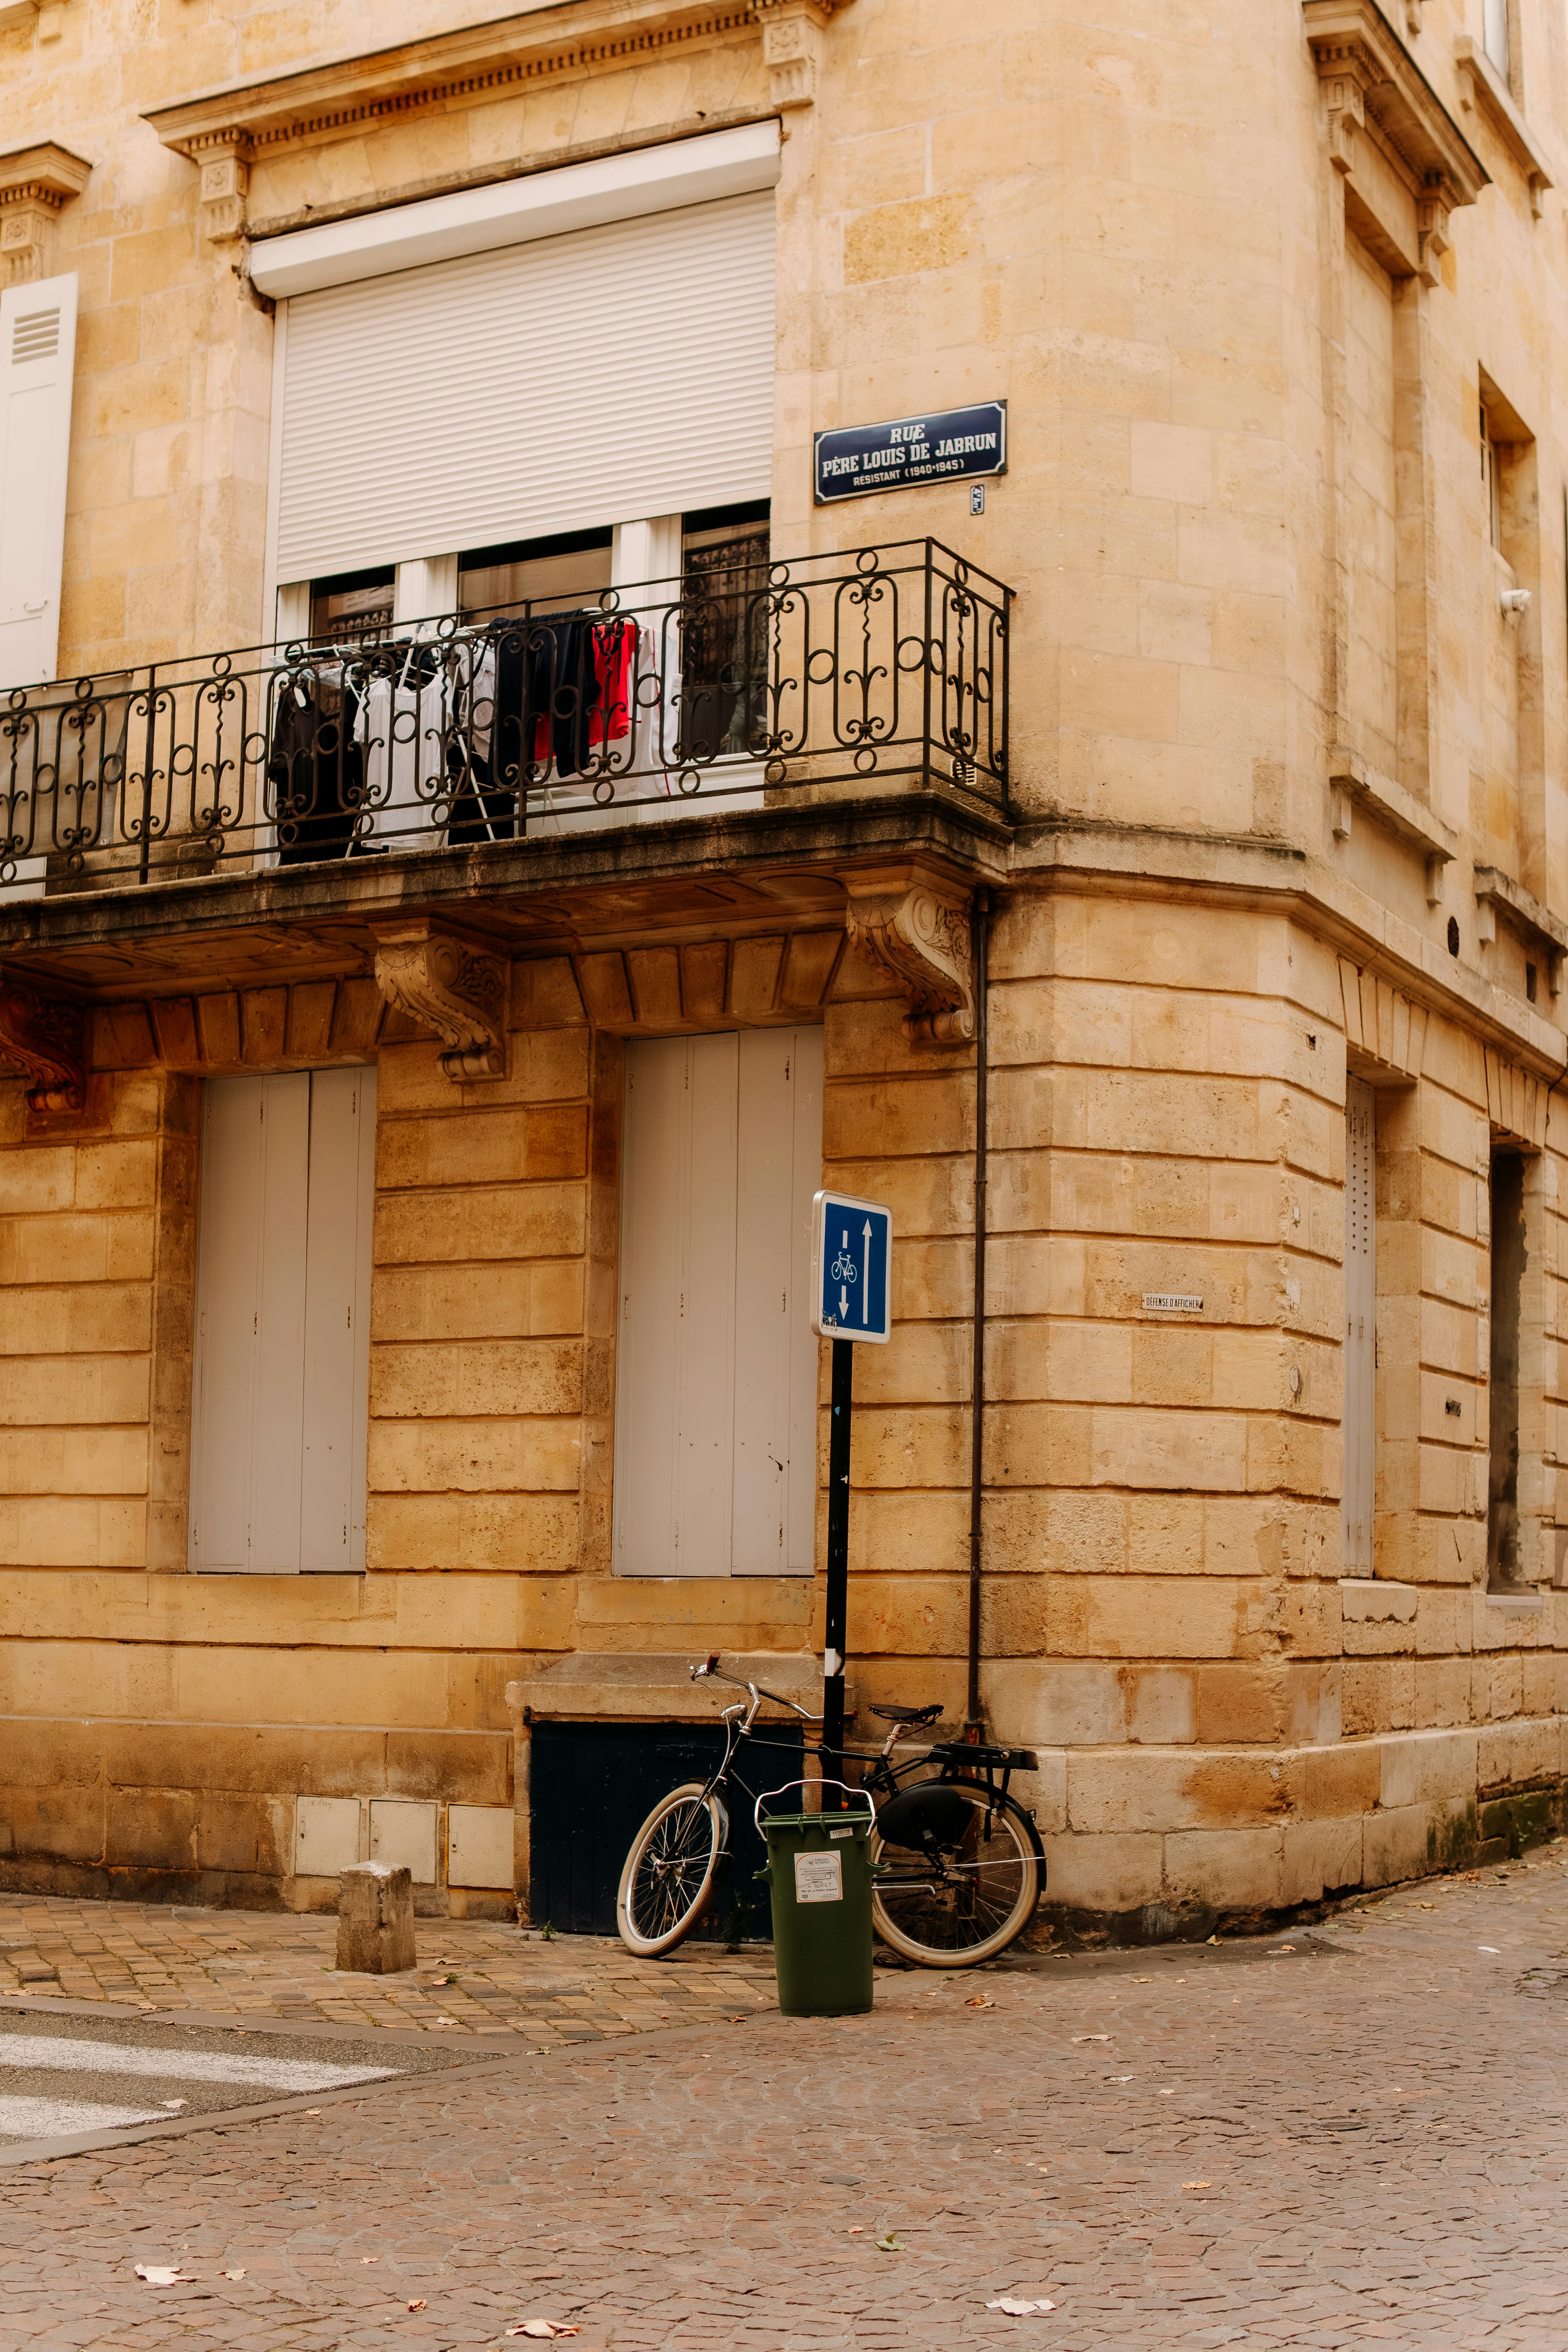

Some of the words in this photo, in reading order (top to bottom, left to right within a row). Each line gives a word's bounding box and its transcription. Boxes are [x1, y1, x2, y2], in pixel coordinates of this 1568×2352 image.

[889, 424, 926, 444] RUE
[822, 456, 859, 477] PÈRE
[863, 446, 906, 470] LOUIS
[910, 443, 930, 461] DE
[935, 432, 996, 457] JABRUN
[853, 469, 900, 486] RÉSISTANT
[1146, 1296, 1168, 1307] DÉFENSE
[1170, 1298, 1200, 1308] D'AFFICHER
